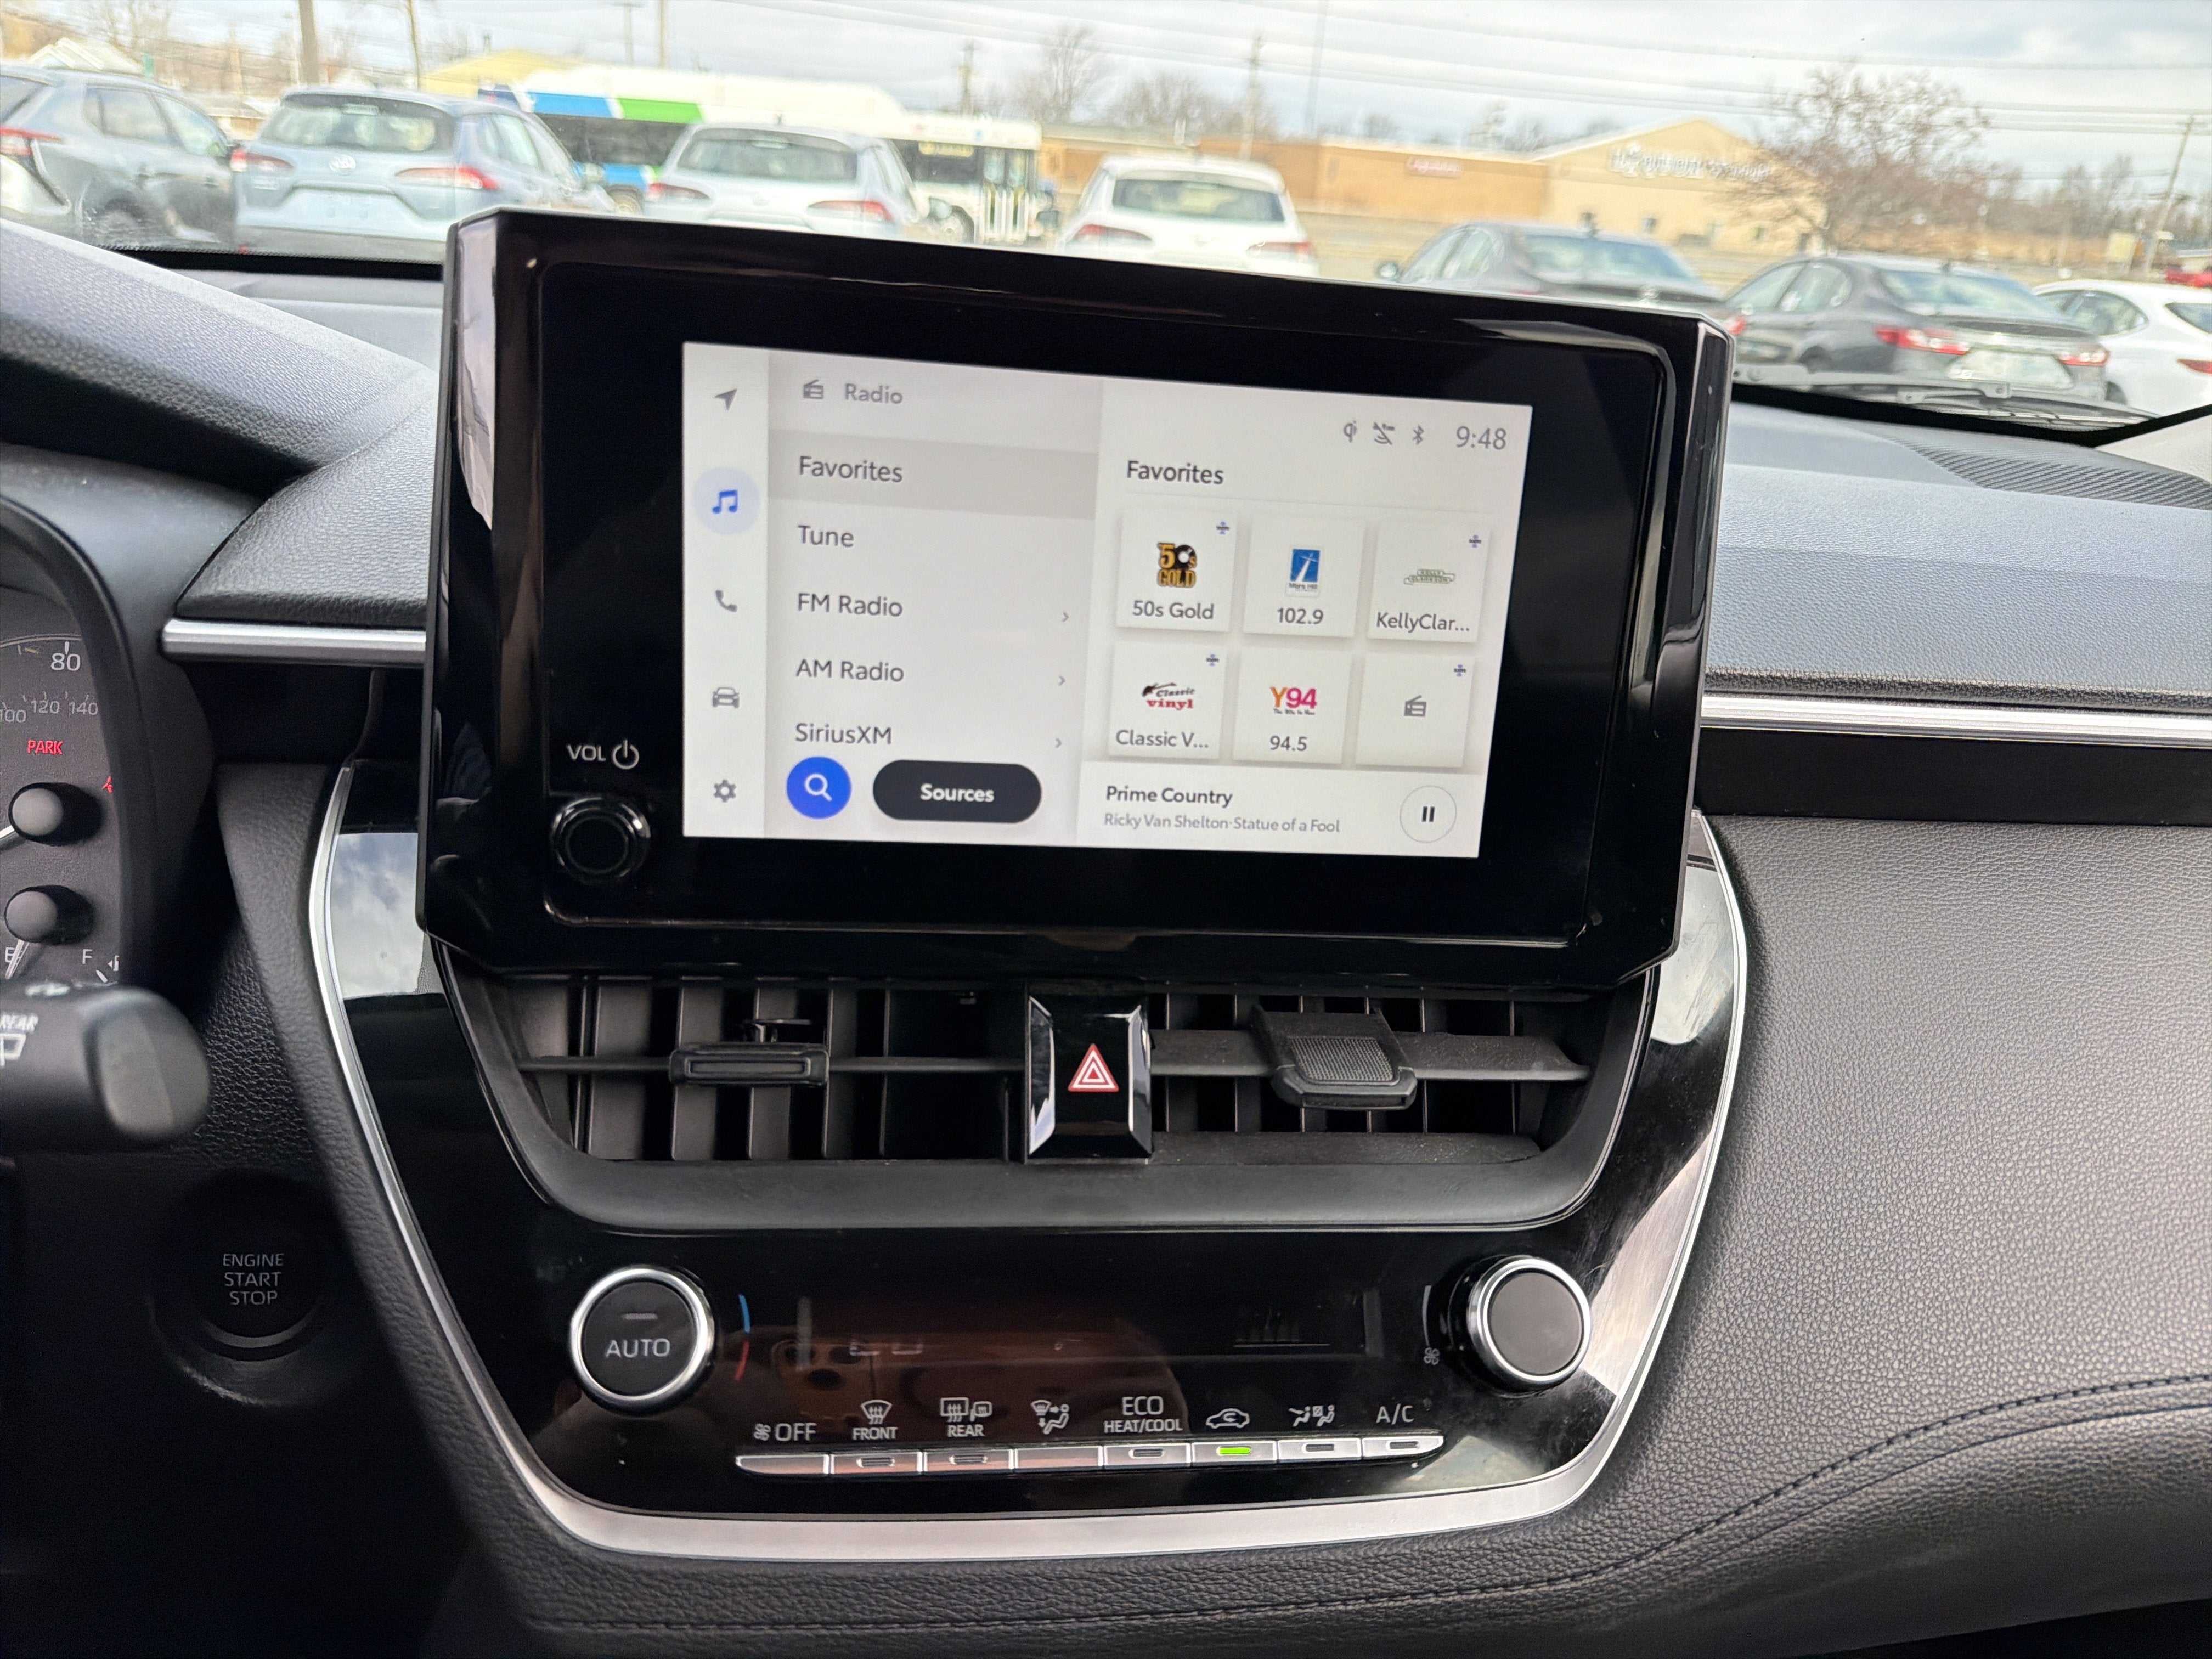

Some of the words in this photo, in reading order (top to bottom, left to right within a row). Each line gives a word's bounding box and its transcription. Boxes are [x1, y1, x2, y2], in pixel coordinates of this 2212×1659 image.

[844, 383, 904, 404] Radio
[1455, 425, 1507, 450] 9:48
[798, 456, 904, 483] Favorites
[1126, 460, 1224, 485] Favorites
[797, 525, 855, 548] Tune
[1157, 569, 1197, 589] GOLD
[797, 592, 830, 613] FM
[838, 595, 904, 617] Radio
[1132, 600, 1164, 617] 50s
[1169, 602, 1215, 620] Gold
[1277, 607, 1324, 625] 102.9
[1376, 612, 1470, 634] KellyClar...
[50, 653, 81, 671] 80
[795, 659, 833, 678] AM
[840, 662, 905, 682] Radio
[1269, 686, 1317, 709] Y94
[31, 700, 60, 714] 120
[69, 702, 98, 715] 140
[795, 723, 893, 745] SiriusXM
[1116, 729, 1177, 747] Classic
[1181, 732, 1209, 748] V...
[1269, 735, 1308, 752] 94.5
[27, 740, 64, 755] PARK
[567, 744, 606, 761] VOL
[920, 783, 995, 803] Sources
[1106, 786, 1158, 803] Prime
[1161, 787, 1233, 808] Country
[1105, 813, 1142, 830] Ricky
[1144, 815, 1172, 828] Van
[1282, 818, 1295, 832] of
[1299, 822, 1307, 831] a
[1311, 819, 1340, 833] Fool
[82, 949, 93, 964] F
[223, 1254, 285, 1267] ENGINE
[224, 1272, 281, 1287] START
[229, 1290, 278, 1305] STOP
[606, 1339, 670, 1358] AUTO
[1122, 1396, 1164, 1415] ECO
[1376, 1404, 1414, 1424] A/C
[774, 1423, 817, 1442] OFF
[852, 1426, 898, 1440] FRONT
[947, 1424, 985, 1437] REAR
[1103, 1419, 1183, 1433] HEAT/COOL
